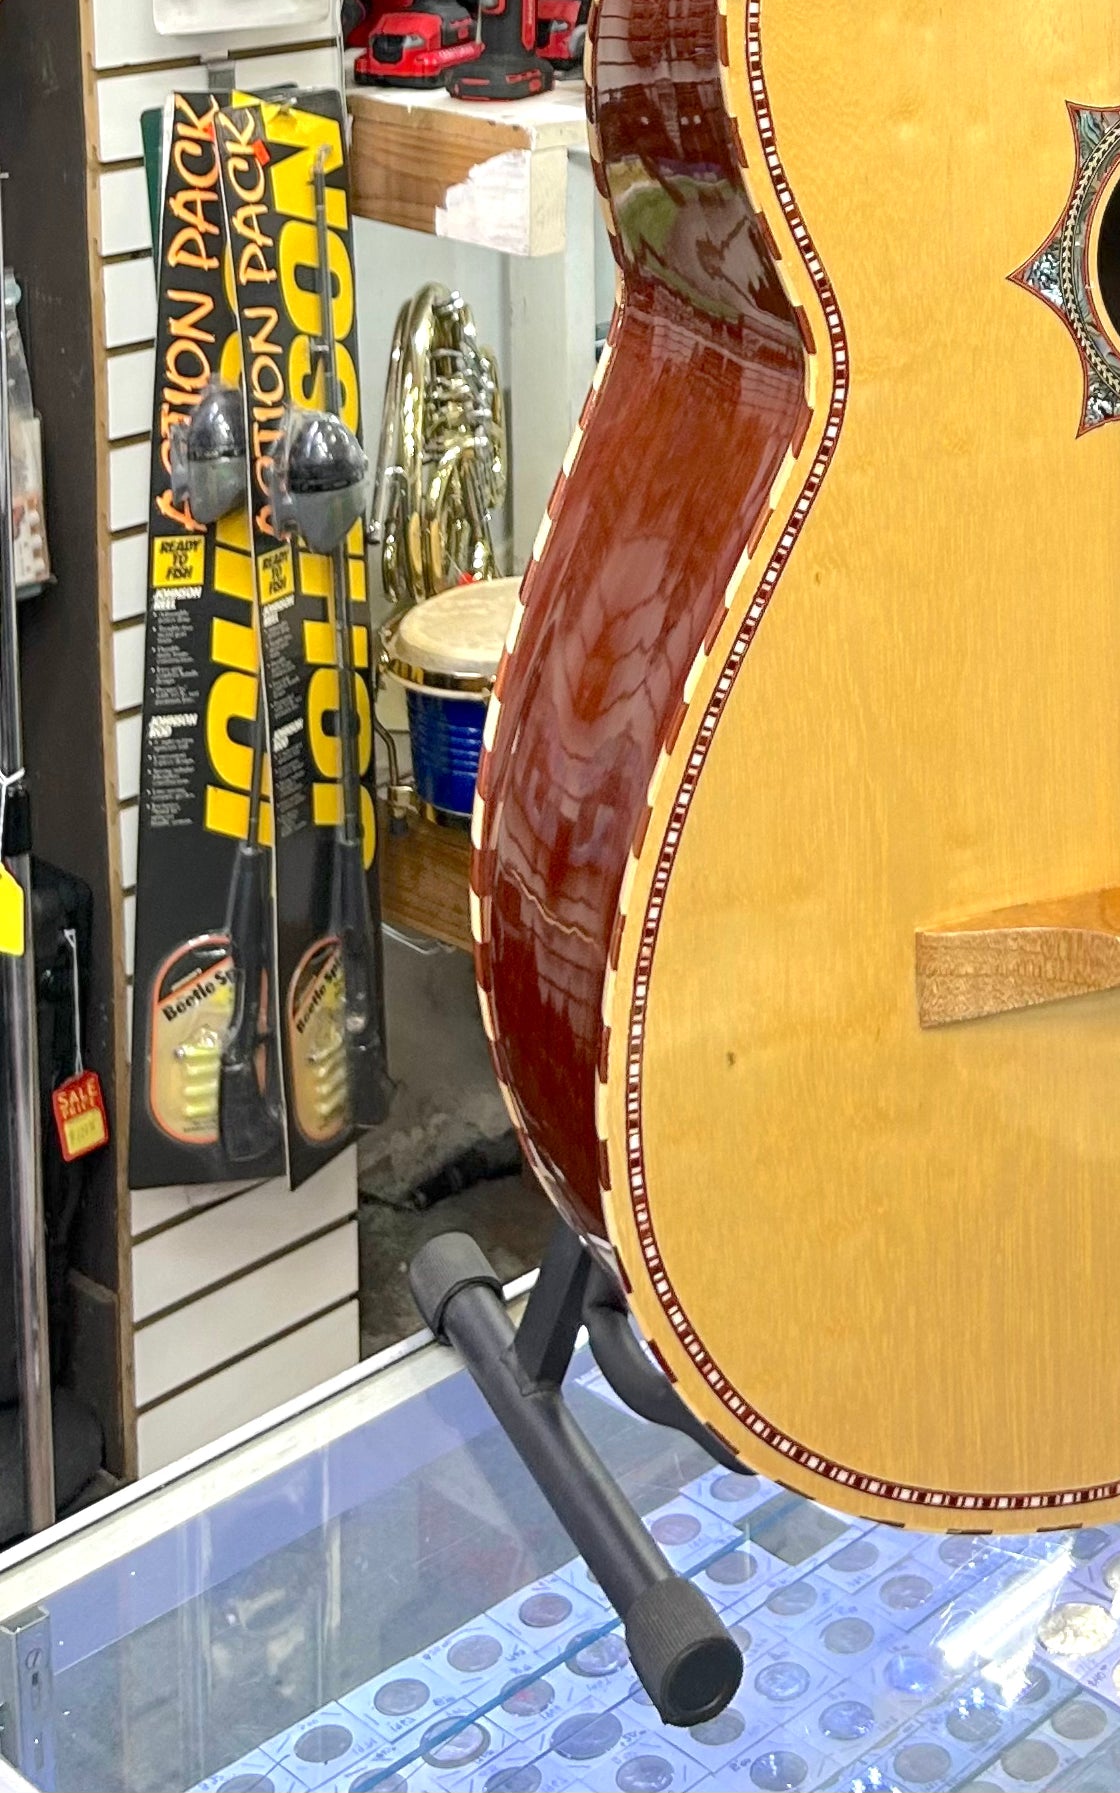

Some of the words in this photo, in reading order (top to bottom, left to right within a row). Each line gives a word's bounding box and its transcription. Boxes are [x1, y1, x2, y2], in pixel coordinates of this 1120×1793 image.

[168, 91, 221, 272] PACK
[218, 107, 278, 286] PACK
[261, 101, 379, 872] JOHSON
[160, 540, 200, 554] READY
[173, 552, 188, 566] TO
[166, 566, 193, 580] FISH
[155, 586, 202, 600] JOHNSON
[150, 713, 199, 728] JOHNSON
[162, 980, 216, 1022] Beetle
[295, 985, 327, 1034] Beetle
[57, 1077, 98, 1107] SALE
